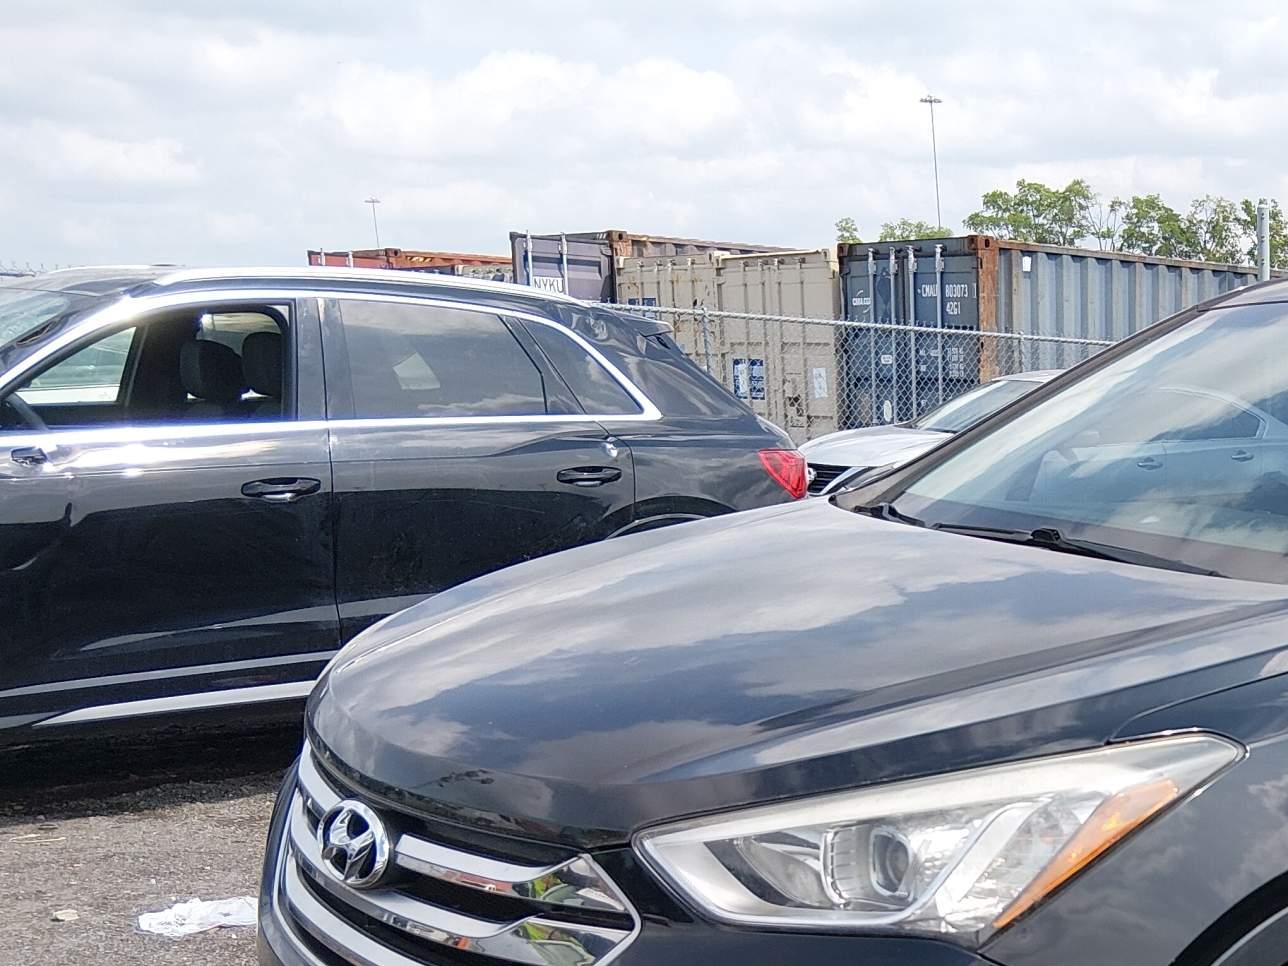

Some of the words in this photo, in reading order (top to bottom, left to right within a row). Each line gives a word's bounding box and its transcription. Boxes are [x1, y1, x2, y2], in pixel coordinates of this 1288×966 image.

[533, 277, 565, 294] NYKU
[945, 284, 968, 298] 803073
[946, 301, 961, 315] 42G1
